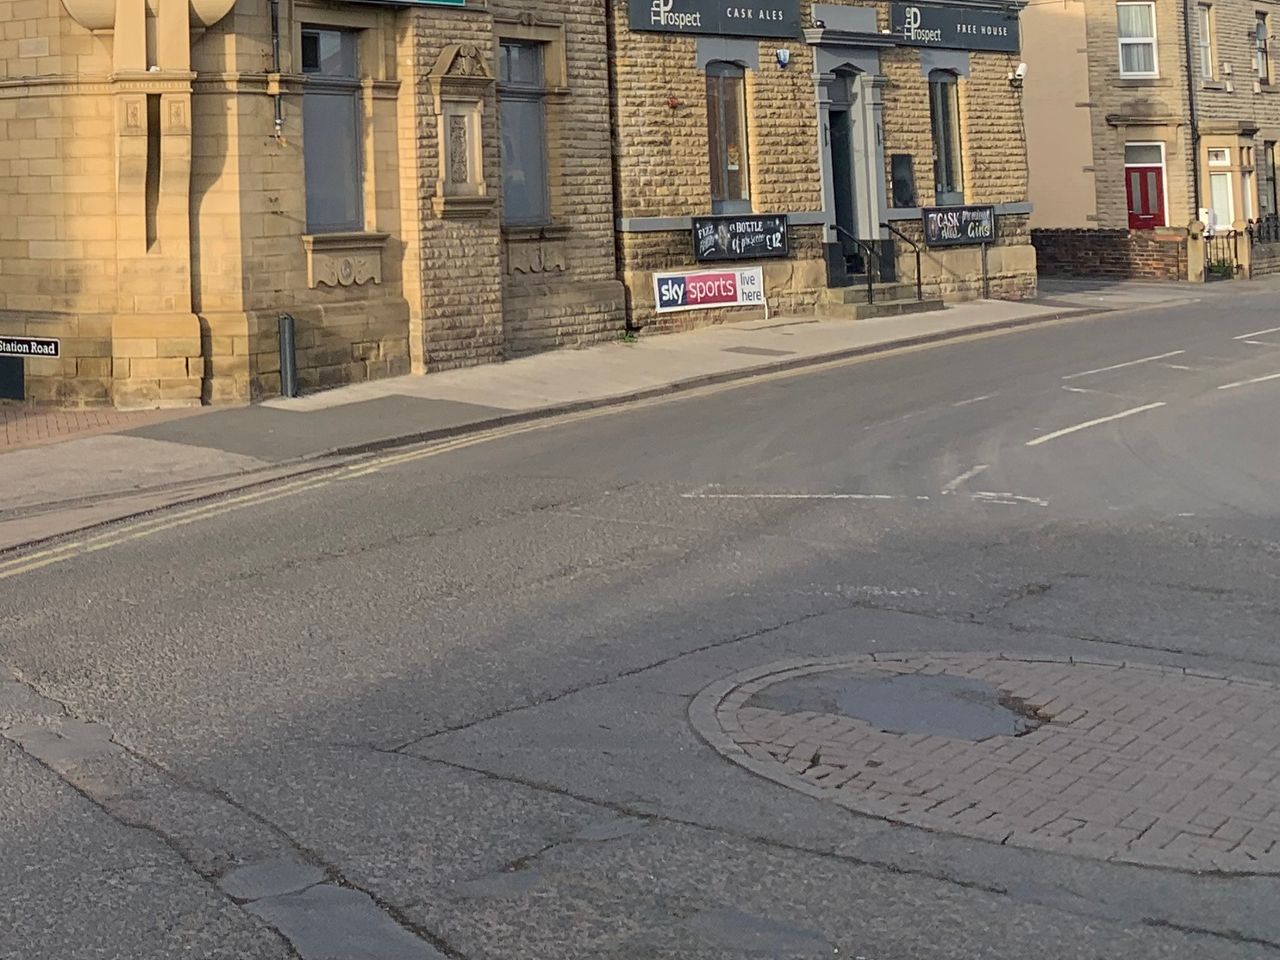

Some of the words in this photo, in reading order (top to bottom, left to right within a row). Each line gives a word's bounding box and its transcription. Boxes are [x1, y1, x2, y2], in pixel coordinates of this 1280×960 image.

[726, 7, 753, 19] CASK
[759, 10, 784, 21] ALES
[904, 7, 912, 40] The
[911, 7, 942, 44] Prospect
[956, 24, 977, 34] FREE
[981, 25, 1008, 36] HOUSE
[736, 221, 764, 233] BOTTLE
[937, 212, 960, 228] CASK
[967, 221, 990, 238] Gins
[766, 232, 782, 250] £12
[661, 279, 685, 304] sky
[689, 277, 734, 301] sports
[740, 273, 756, 286] live
[742, 288, 762, 302] here
[30, 341, 56, 354] Road
